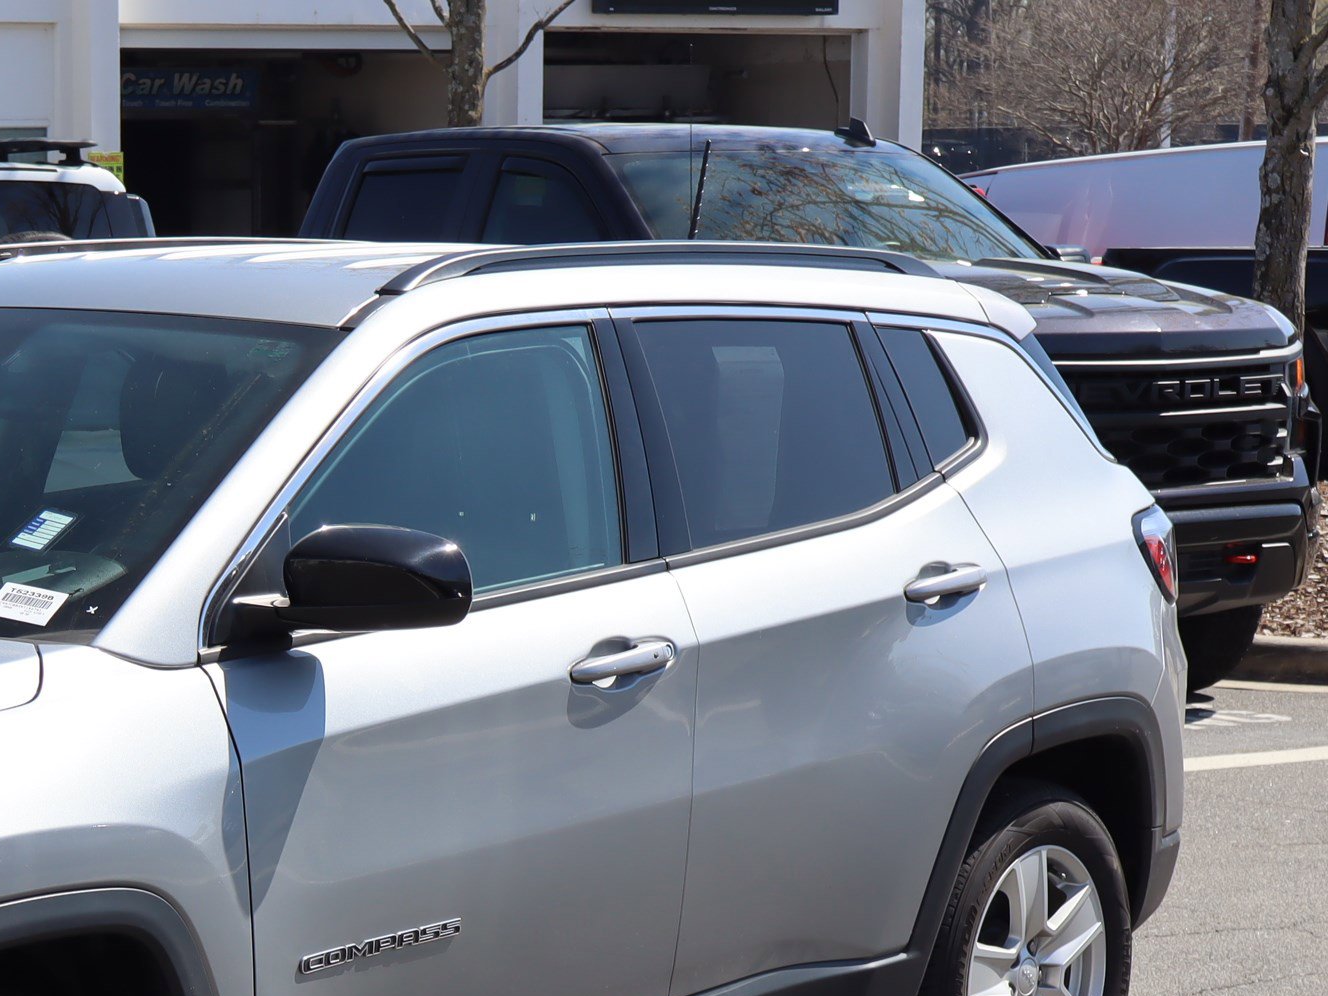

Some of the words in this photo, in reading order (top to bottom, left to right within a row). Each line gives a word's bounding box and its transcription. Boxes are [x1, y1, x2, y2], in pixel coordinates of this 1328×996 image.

[121, 72, 165, 95] Car
[173, 72, 244, 95] Wash
[1075, 373, 1285, 402] EVROLET
[300, 917, 462, 975] COMPASS
